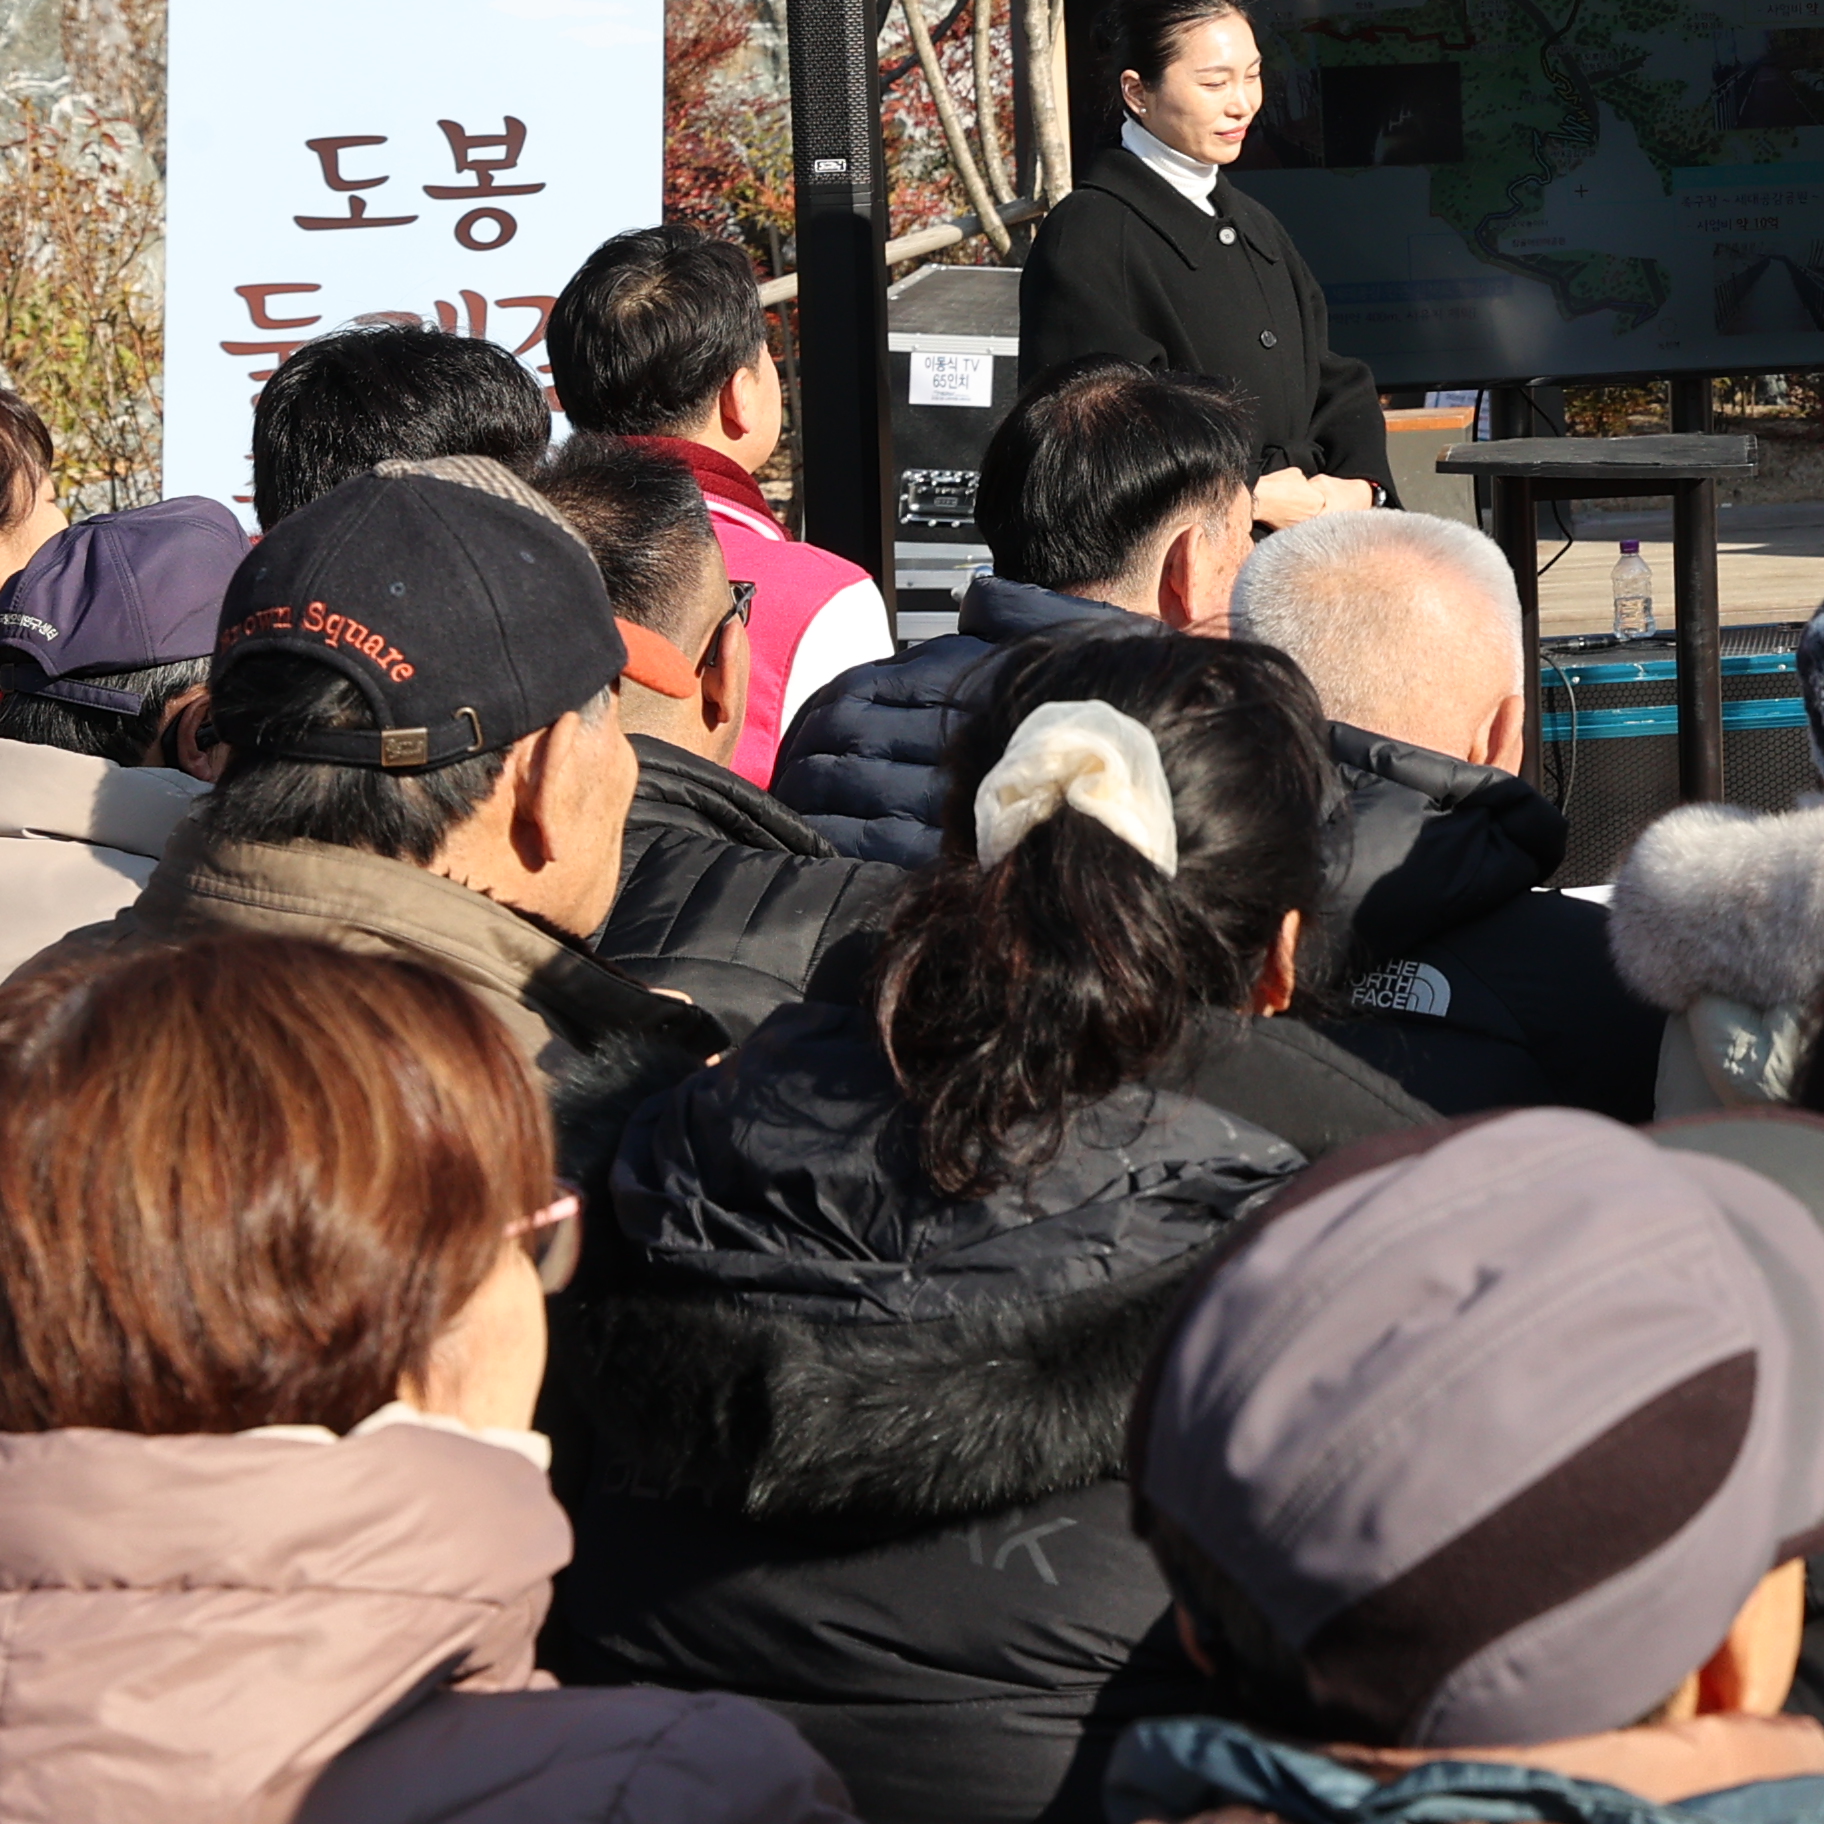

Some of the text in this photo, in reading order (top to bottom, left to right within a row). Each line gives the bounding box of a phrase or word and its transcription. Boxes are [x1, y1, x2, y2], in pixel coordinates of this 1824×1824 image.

[293, 115, 547, 252] 도봉
[924, 356, 980, 373] 이동식 TV
[932, 373, 969, 390] 65인치
[303, 600, 416, 683] Square
[1377, 958, 1418, 977] HE
[1351, 987, 1408, 1010] FACE
